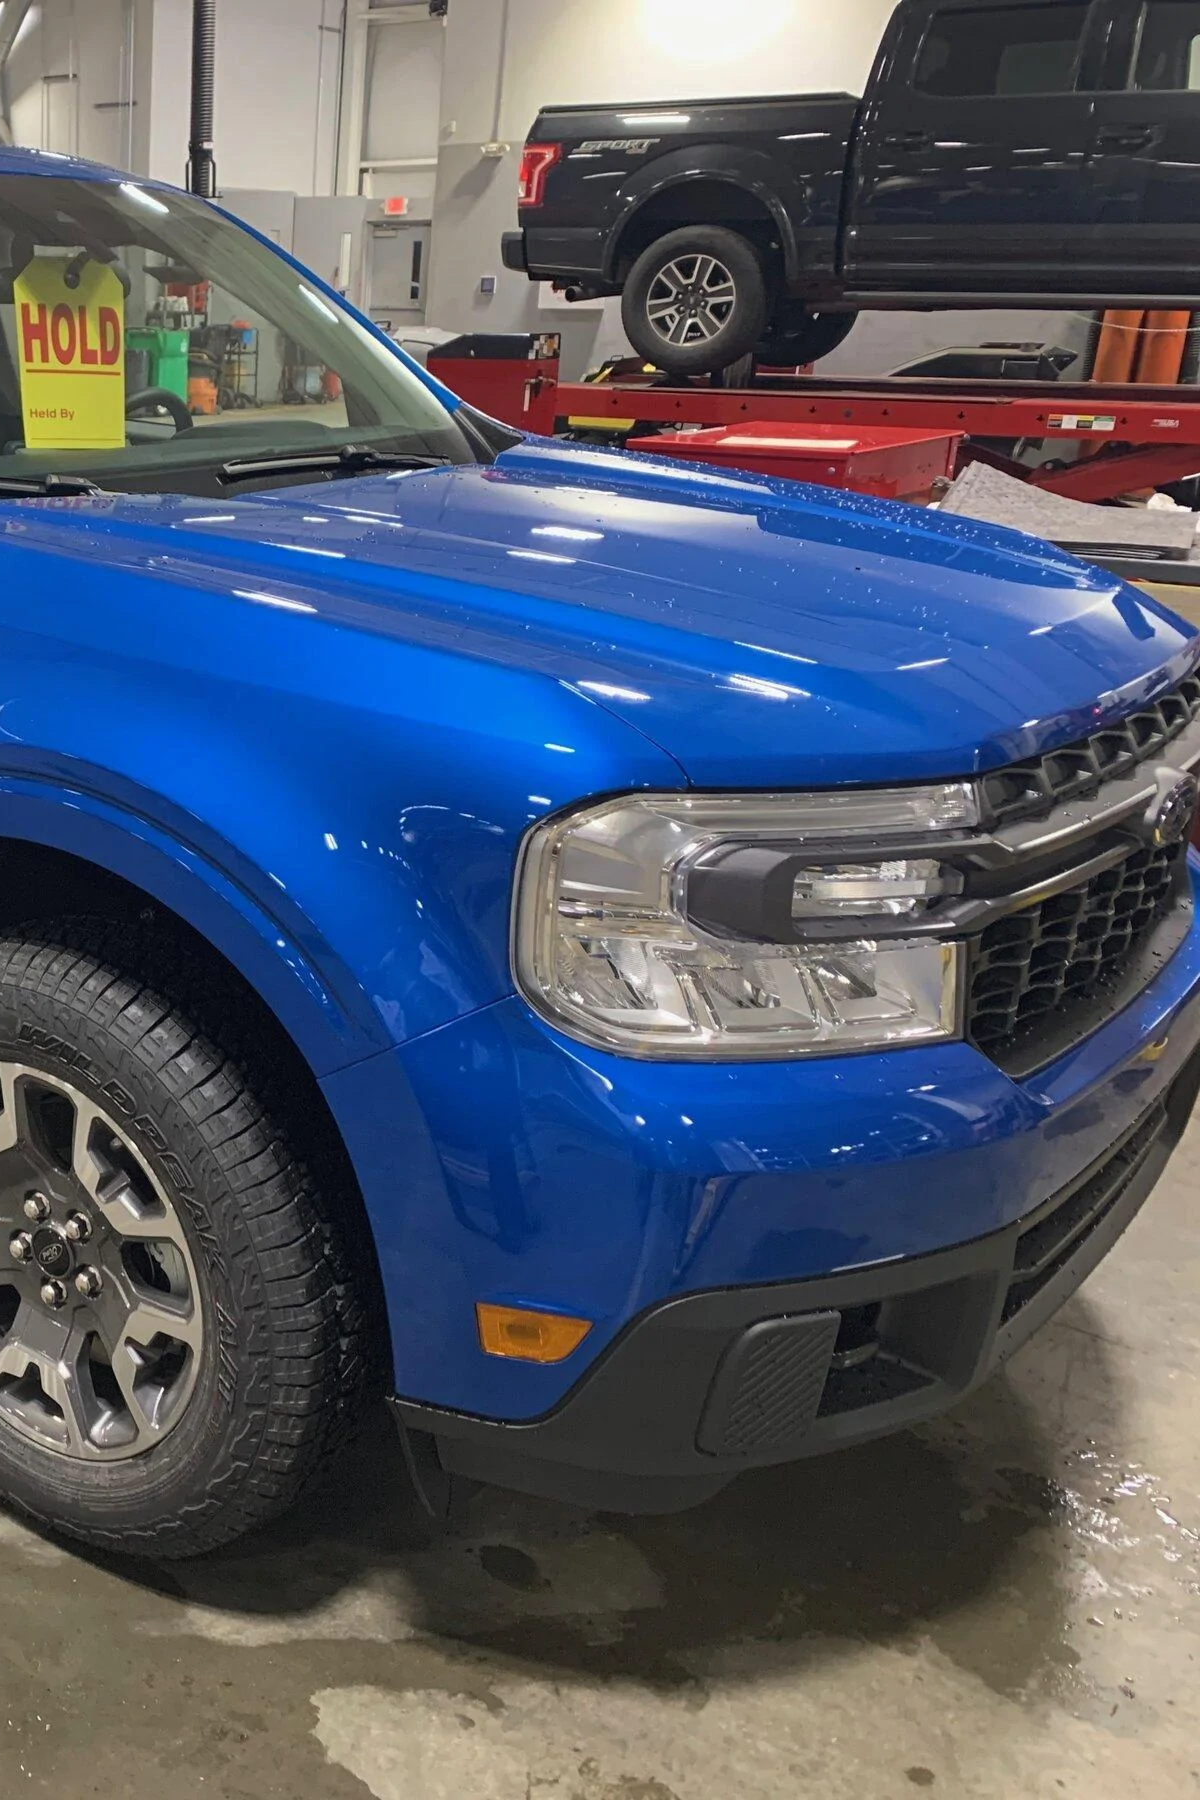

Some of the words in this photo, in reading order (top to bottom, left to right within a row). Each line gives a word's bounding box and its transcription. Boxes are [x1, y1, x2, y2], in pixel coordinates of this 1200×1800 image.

[21, 302, 121, 366] HOLD
[29, 408, 57, 418] Held
[60, 408, 75, 420] By
[16, 1022, 227, 1274] WILDPEAK
